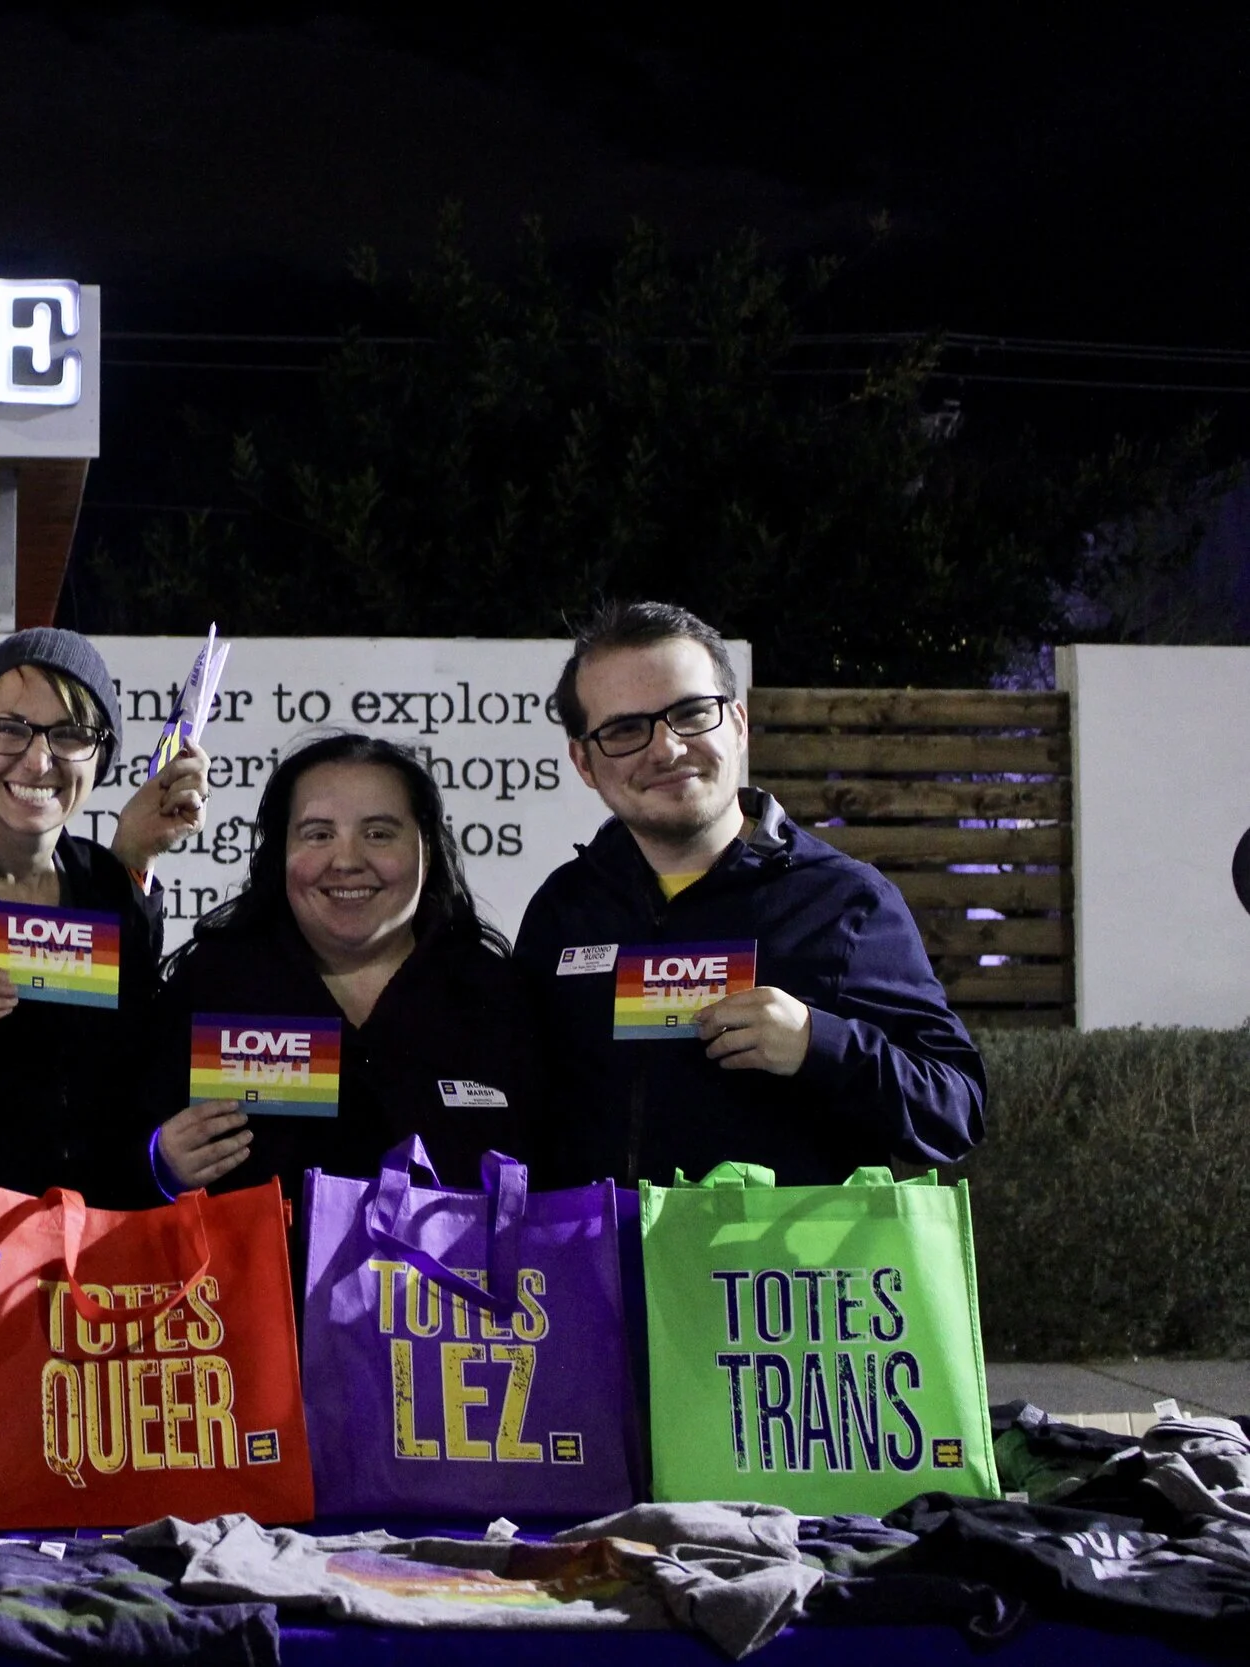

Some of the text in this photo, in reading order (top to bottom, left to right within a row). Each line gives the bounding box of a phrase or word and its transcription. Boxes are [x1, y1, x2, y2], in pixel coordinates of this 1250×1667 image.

[112, 680, 562, 734] nter to explore
[410, 746, 560, 800] hops
[8, 916, 93, 947] LOVE
[644, 957, 728, 982] LOVE
[221, 1030, 311, 1056] LOVE
[37, 1276, 224, 1355] TOTES
[711, 1267, 907, 1345] TOTES
[42, 1354, 240, 1488] QUEER
[390, 1338, 543, 1462] LEZ
[715, 1350, 925, 1474] TRANS
